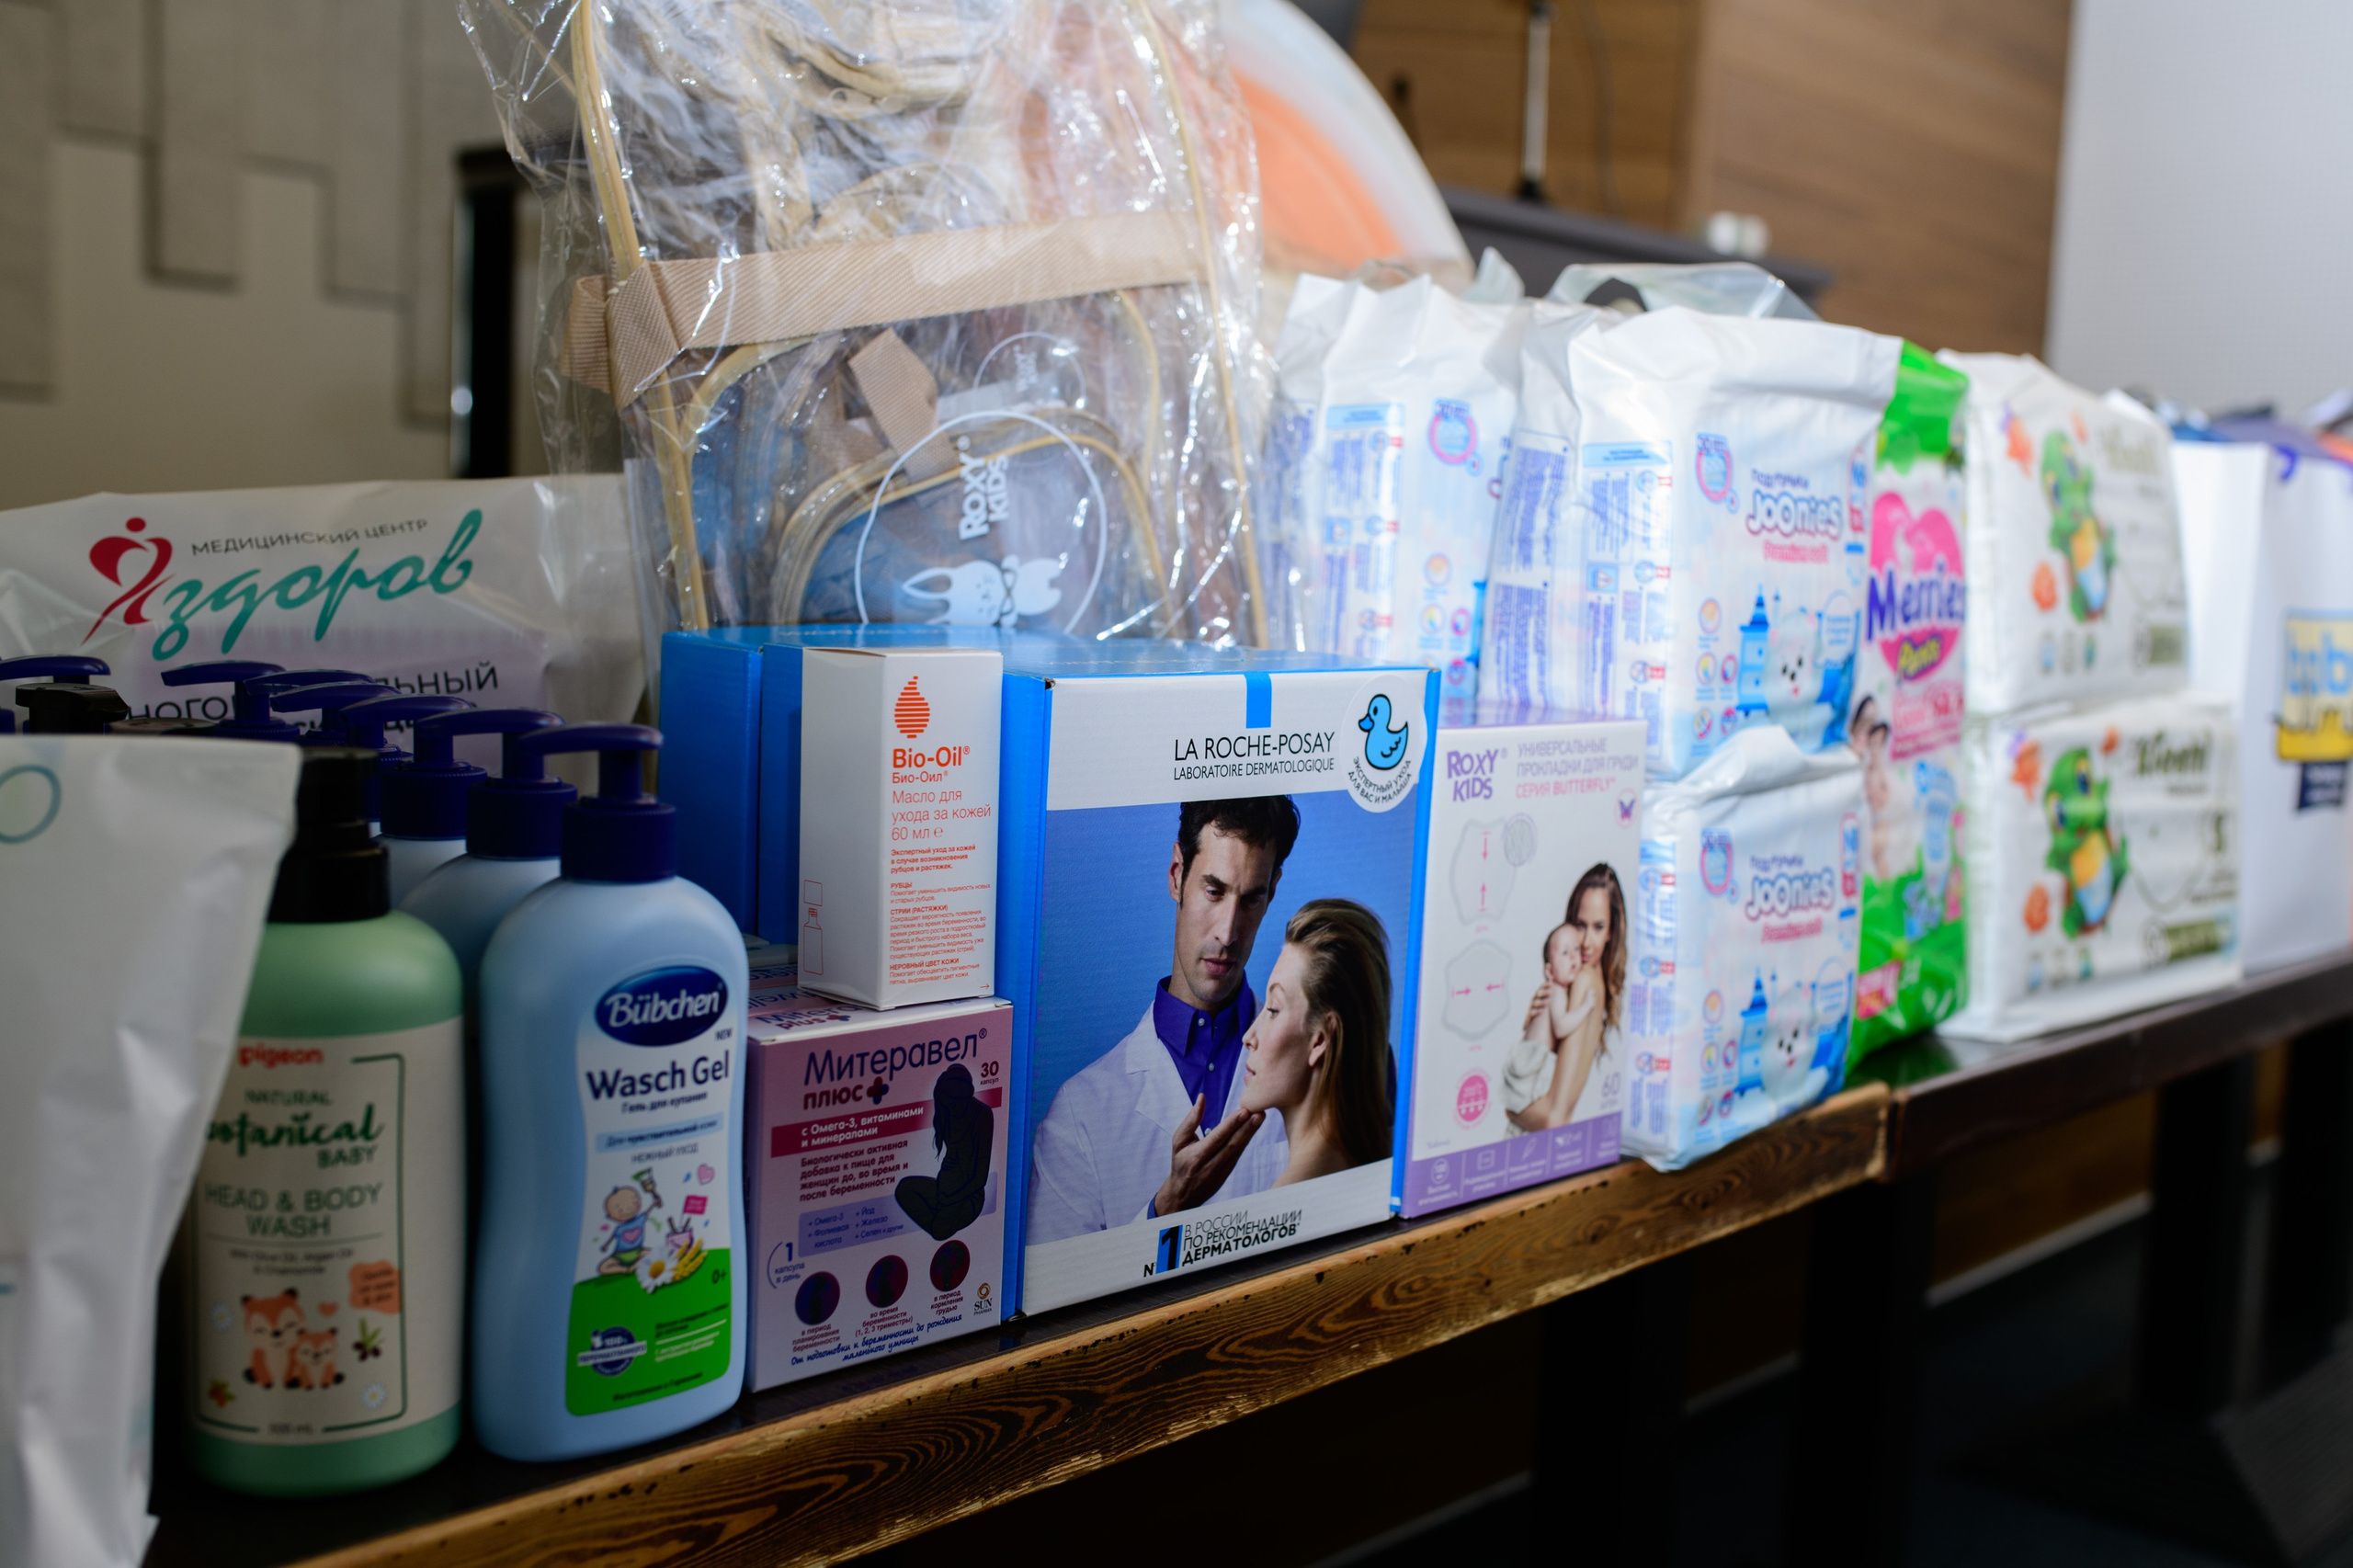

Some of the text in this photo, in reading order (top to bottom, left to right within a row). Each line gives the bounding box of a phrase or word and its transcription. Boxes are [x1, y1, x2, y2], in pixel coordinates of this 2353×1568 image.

[988, 454, 1009, 521] KIDS
[192, 518, 428, 555] МЕДИЦИНСКИЙ ЦЕНТР
[152, 508, 483, 661] здоров
[1175, 732, 1335, 762] LA ROCHE-POSAY
[1518, 737, 1608, 758] УНИВЕРСАЛЬНЫЕ
[1174, 757, 1335, 780] LABORATOIRE DERMATOLOGIQUE
[1353, 756, 1392, 793] ЭКСПЕРТНЫЙ
[1517, 758, 1582, 778] ПРОКЛАДКИ
[1348, 771, 1361, 791] ДЛЯ
[1359, 788, 1374, 802] ВАС
[1381, 773, 1412, 803] МАЛЫША
[1452, 778, 1494, 802] KIDS
[892, 790, 962, 804] Масло для
[892, 804, 992, 825] ухода за кожей
[891, 827, 930, 841] 60 мл
[891, 847, 931, 857] Экспертный
[932, 846, 948, 855] уход
[956, 844, 976, 852] кожей
[920, 854, 969, 863] возникновения
[891, 866, 915, 874] рубцов
[920, 864, 954, 872] растяжек.
[891, 881, 913, 890] РУБЦЫ
[917, 888, 947, 896] уменьшить
[891, 904, 949, 915] СТРИИ (РАСТЯЖКИ)
[890, 961, 925, 971] НЕРОВНЫЙ
[925, 960, 940, 968] ЦВЕТ
[605, 989, 721, 1028] Bübchen
[776, 1018, 826, 1030] plus
[585, 1050, 730, 1102] Wasch Gel
[980, 1060, 1000, 1078] 30
[980, 1077, 999, 1086] капсул
[803, 1085, 864, 1110] плюс
[208, 1102, 386, 1158] otanical
[811, 1118, 858, 1136] Омега-3,
[860, 1106, 925, 1127] витаминами
[811, 1127, 879, 1147] минералами
[801, 1140, 908, 1168] Биологически активная
[800, 1164, 840, 1180] добавка
[851, 1157, 876, 1170] пище
[878, 1153, 895, 1165] для
[800, 1176, 840, 1190] женщин
[842, 1172, 857, 1184] до,
[858, 1169, 870, 1179] во
[872, 1164, 901, 1177] время
[204, 1182, 269, 1212] HEAD
[303, 1182, 383, 1213] BODY
[800, 1176, 896, 1202] после беременности
[813, 1213, 845, 1226] Омега-3
[860, 1207, 876, 1217] Йод
[245, 1213, 332, 1239] WASH
[813, 1222, 850, 1237] Фолиевая
[860, 1215, 889, 1228] Железо
[1183, 1209, 1303, 1251] ПО РЕКОМЕНДАЦИИ
[1185, 1210, 1248, 1237] В РОССИИ
[860, 1229, 882, 1239] Селен
[886, 1223, 904, 1234] другие
[813, 1236, 843, 1249] кислота
[785, 1242, 794, 1263] 1
[711, 1268, 727, 1285] 0+
[774, 1262, 805, 1275] капсула
[782, 1273, 801, 1285] день
[930, 1297, 964, 1311] кормления
[939, 1290, 961, 1301] период
[973, 1298, 993, 1311] SUN
[862, 1311, 907, 1327] беременности
[879, 1307, 899, 1318] время
[936, 1305, 958, 1316] грудью
[806, 1324, 832, 1336] период
[876, 1316, 914, 1332] триместры)
[791, 1329, 840, 1346] планирования
[791, 1354, 804, 1366] От
[807, 1344, 851, 1362] подготовки
[861, 1326, 915, 1347] беременности
[926, 1314, 963, 1332] рождения
[792, 1335, 841, 1353] беременности
[842, 1335, 919, 1361] маленького умницы
